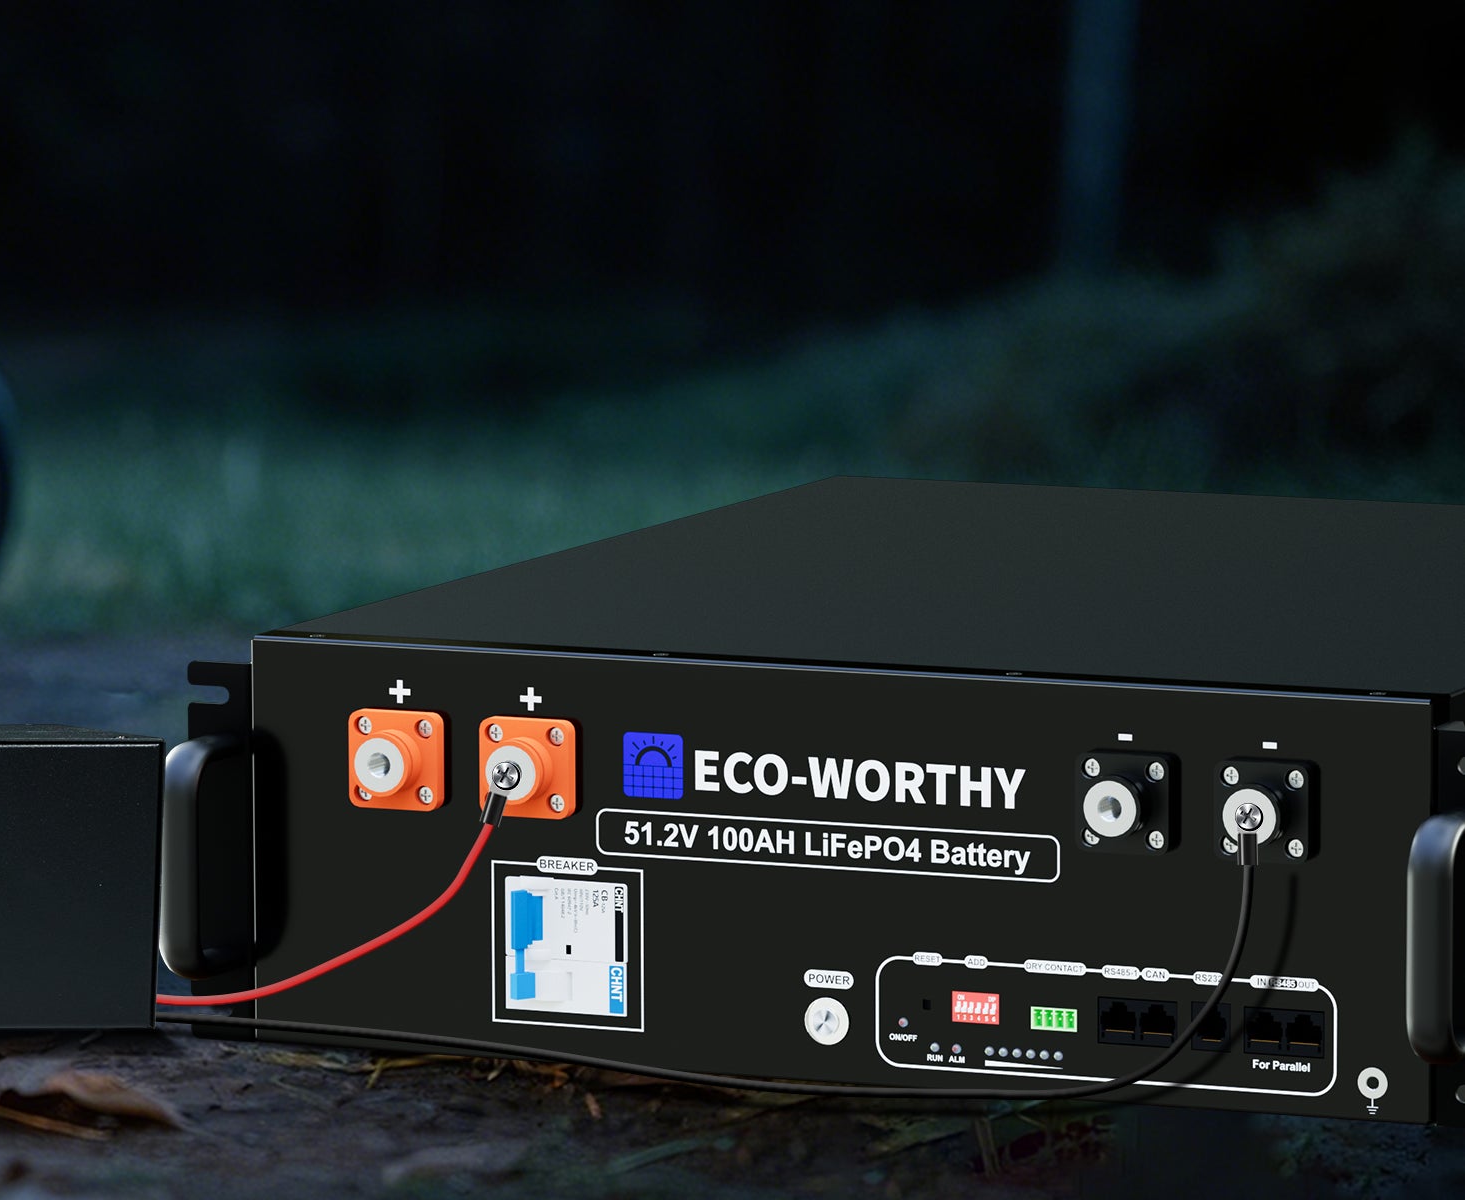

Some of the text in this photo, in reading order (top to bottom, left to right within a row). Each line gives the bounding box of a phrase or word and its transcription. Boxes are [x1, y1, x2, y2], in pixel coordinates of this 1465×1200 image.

[693, 748, 1028, 811] ECO-WORTHY
[624, 820, 1031, 876] 51.2V 100AH LiFePO4 Battery
[539, 858, 595, 872] BREAKER
[614, 886, 624, 913] CHNT
[914, 955, 940, 963] RESET
[968, 958, 986, 967] ADD
[1025, 962, 1083, 973] DRY CONTACT
[808, 973, 850, 985] POWER
[1145, 970, 1166, 979] CAN
[610, 967, 623, 1002] CHNT
[1257, 977, 1267, 986] IN
[1298, 980, 1315, 989] OUT
[888, 1032, 918, 1043] ON/OFF
[926, 1053, 944, 1063] RUN
[948, 1055, 966, 1065] ALM
[1252, 1058, 1311, 1073] For Parallel
